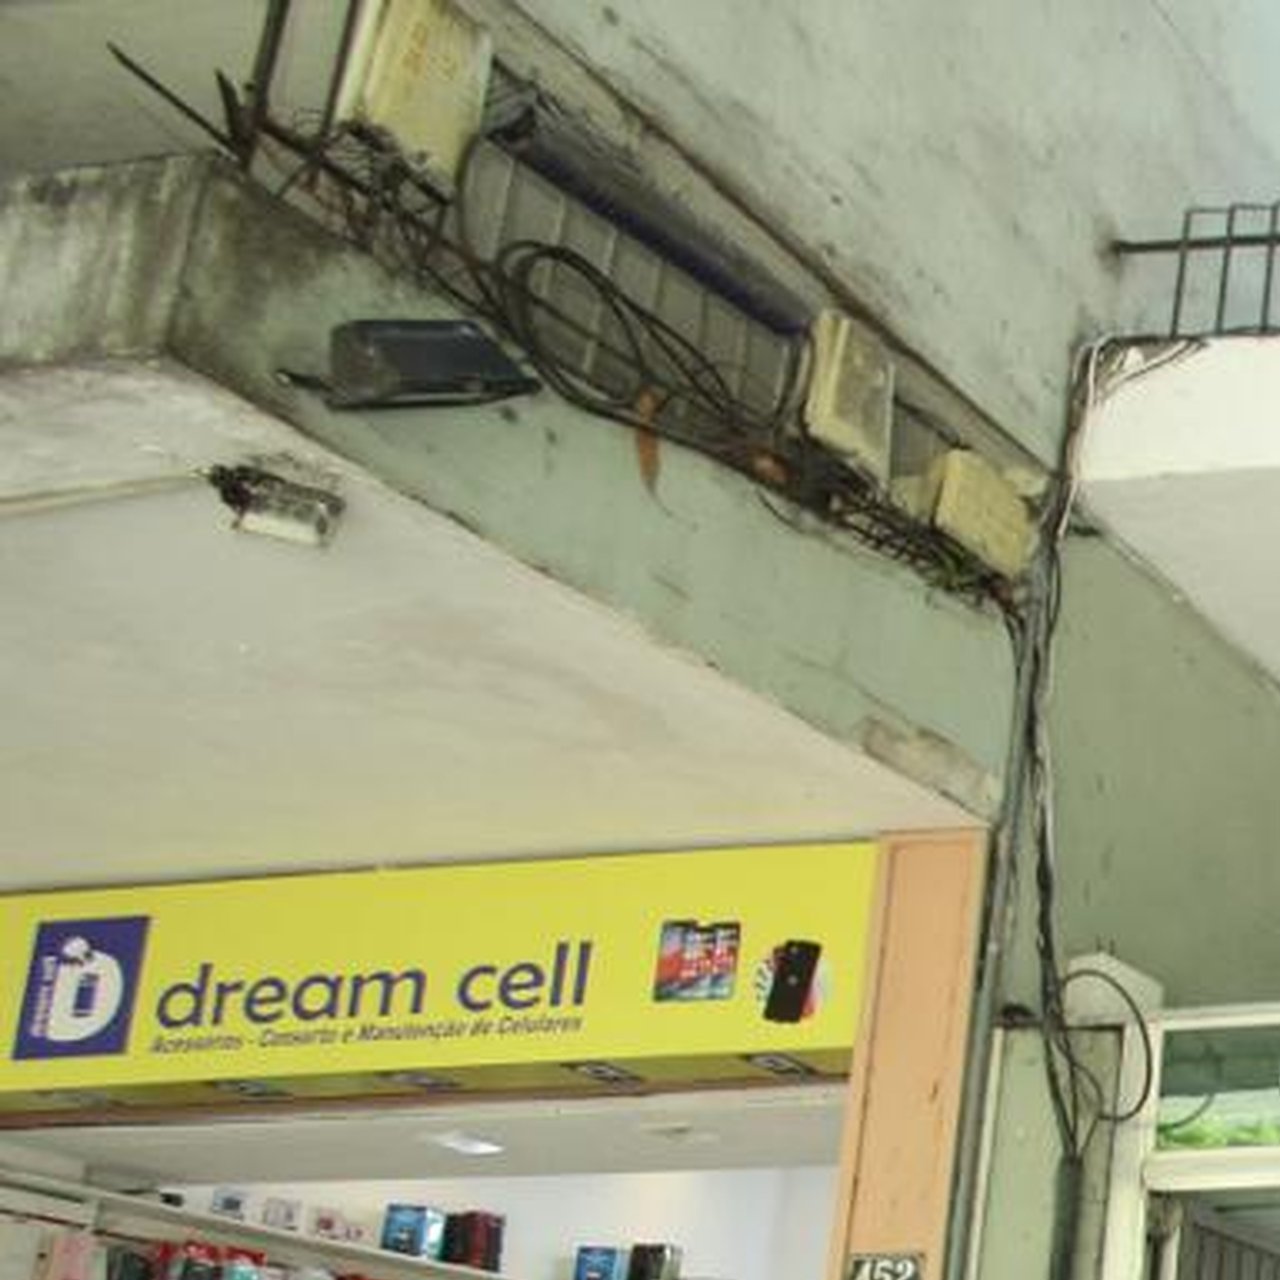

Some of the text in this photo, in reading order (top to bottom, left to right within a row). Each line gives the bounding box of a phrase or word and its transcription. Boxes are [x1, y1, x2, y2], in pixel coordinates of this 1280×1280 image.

[156, 941, 592, 1029] dream cell
[469, 1018, 494, 1036] de
[497, 1014, 583, 1035] Celulares
